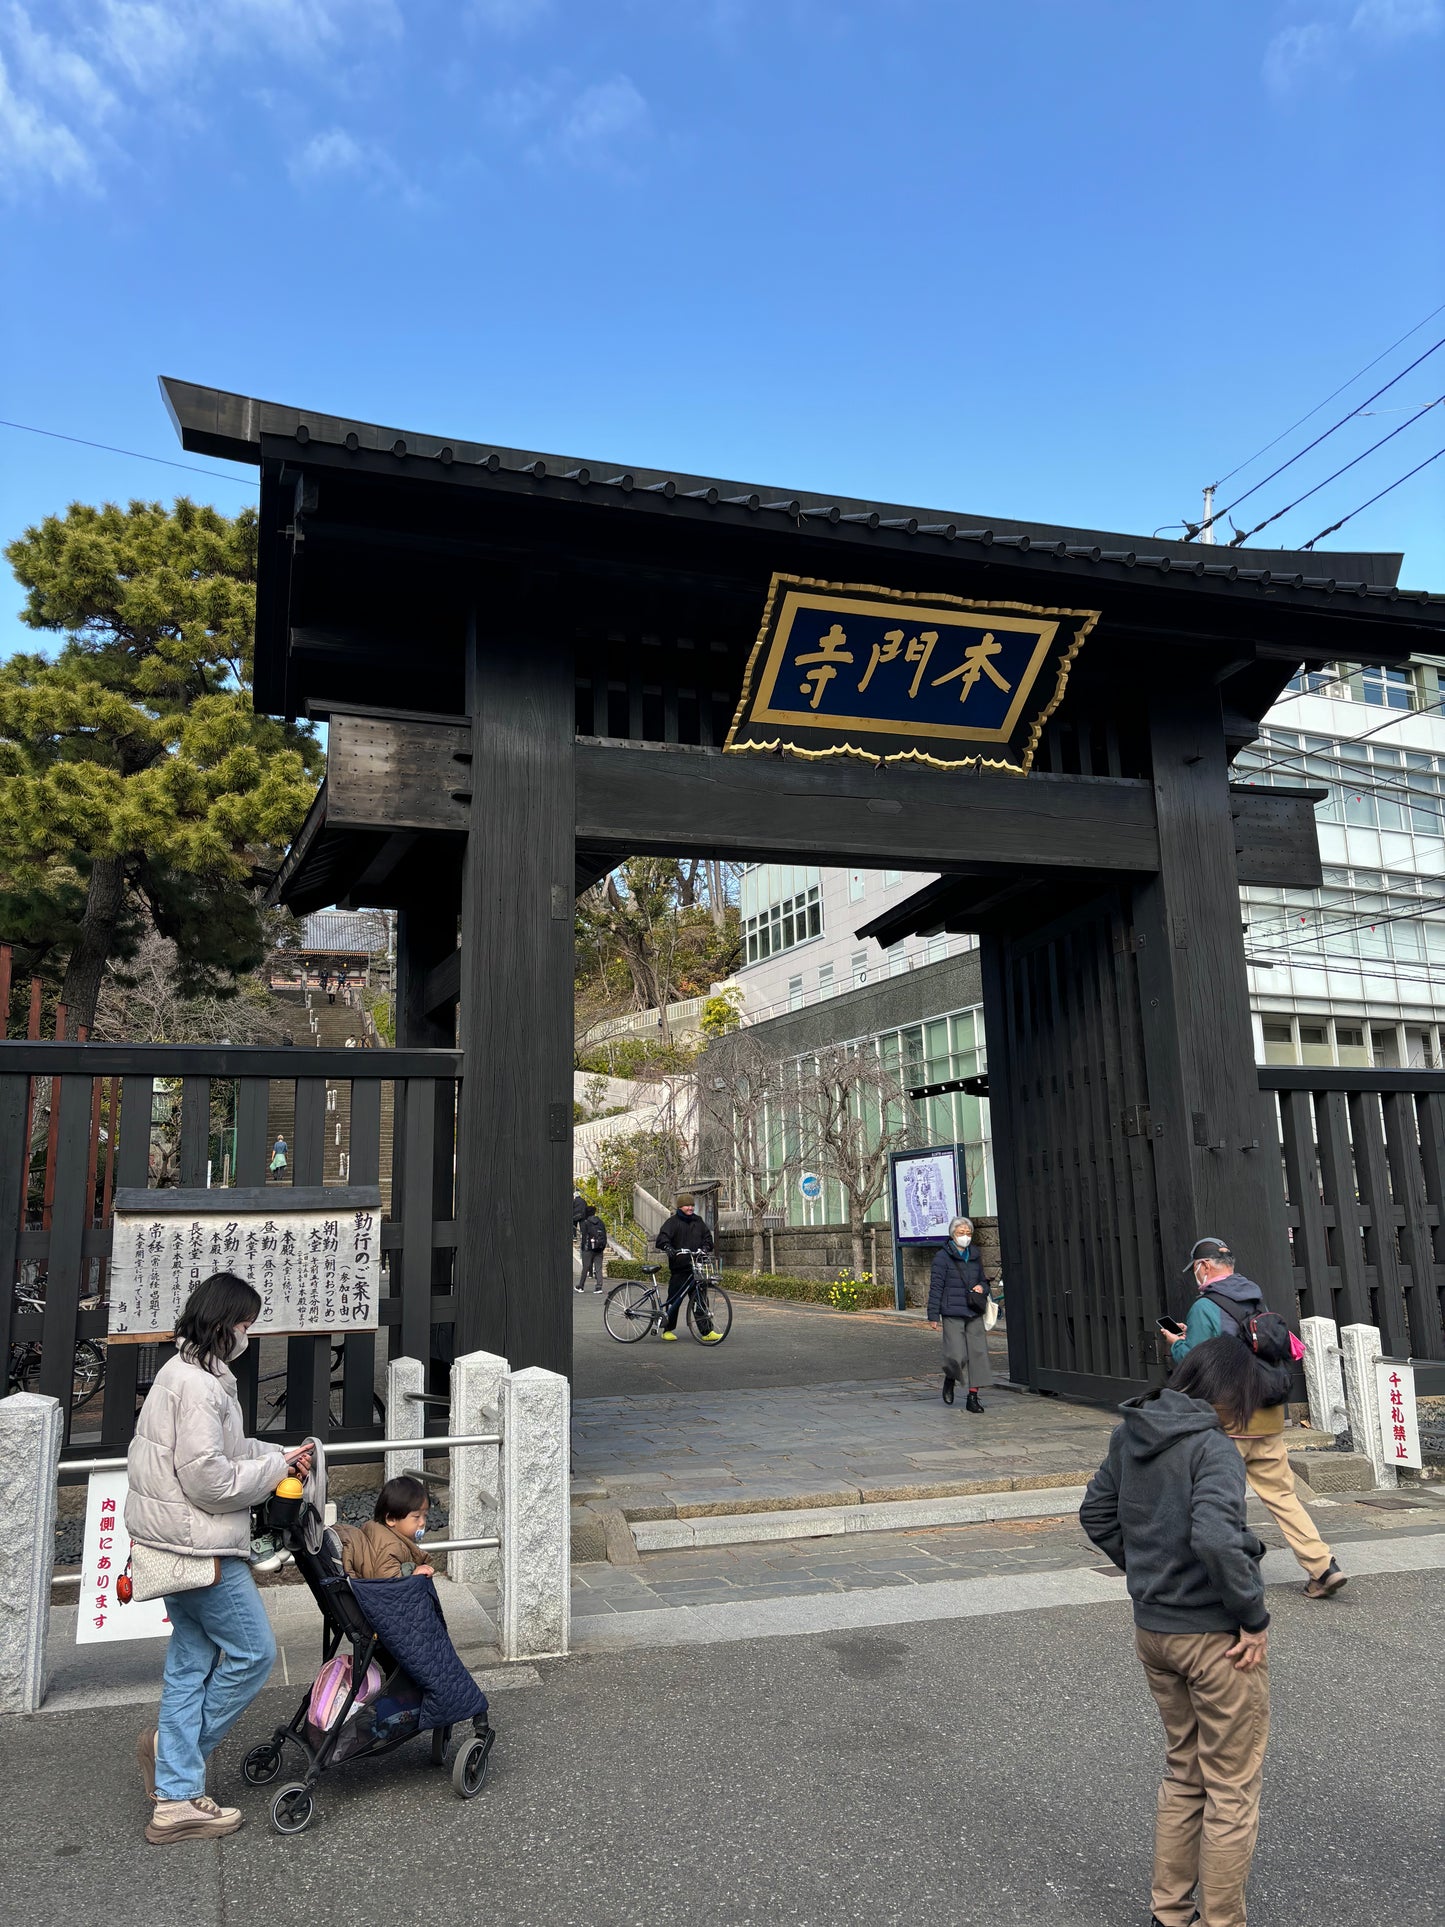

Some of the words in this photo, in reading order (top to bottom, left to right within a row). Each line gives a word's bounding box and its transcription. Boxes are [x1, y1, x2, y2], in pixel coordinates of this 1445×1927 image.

[352, 1211, 373, 1321] 勤行のご案内
[1388, 1371, 1409, 1459] 千社札禁止
[92, 1497, 116, 1630] 内側にあります
